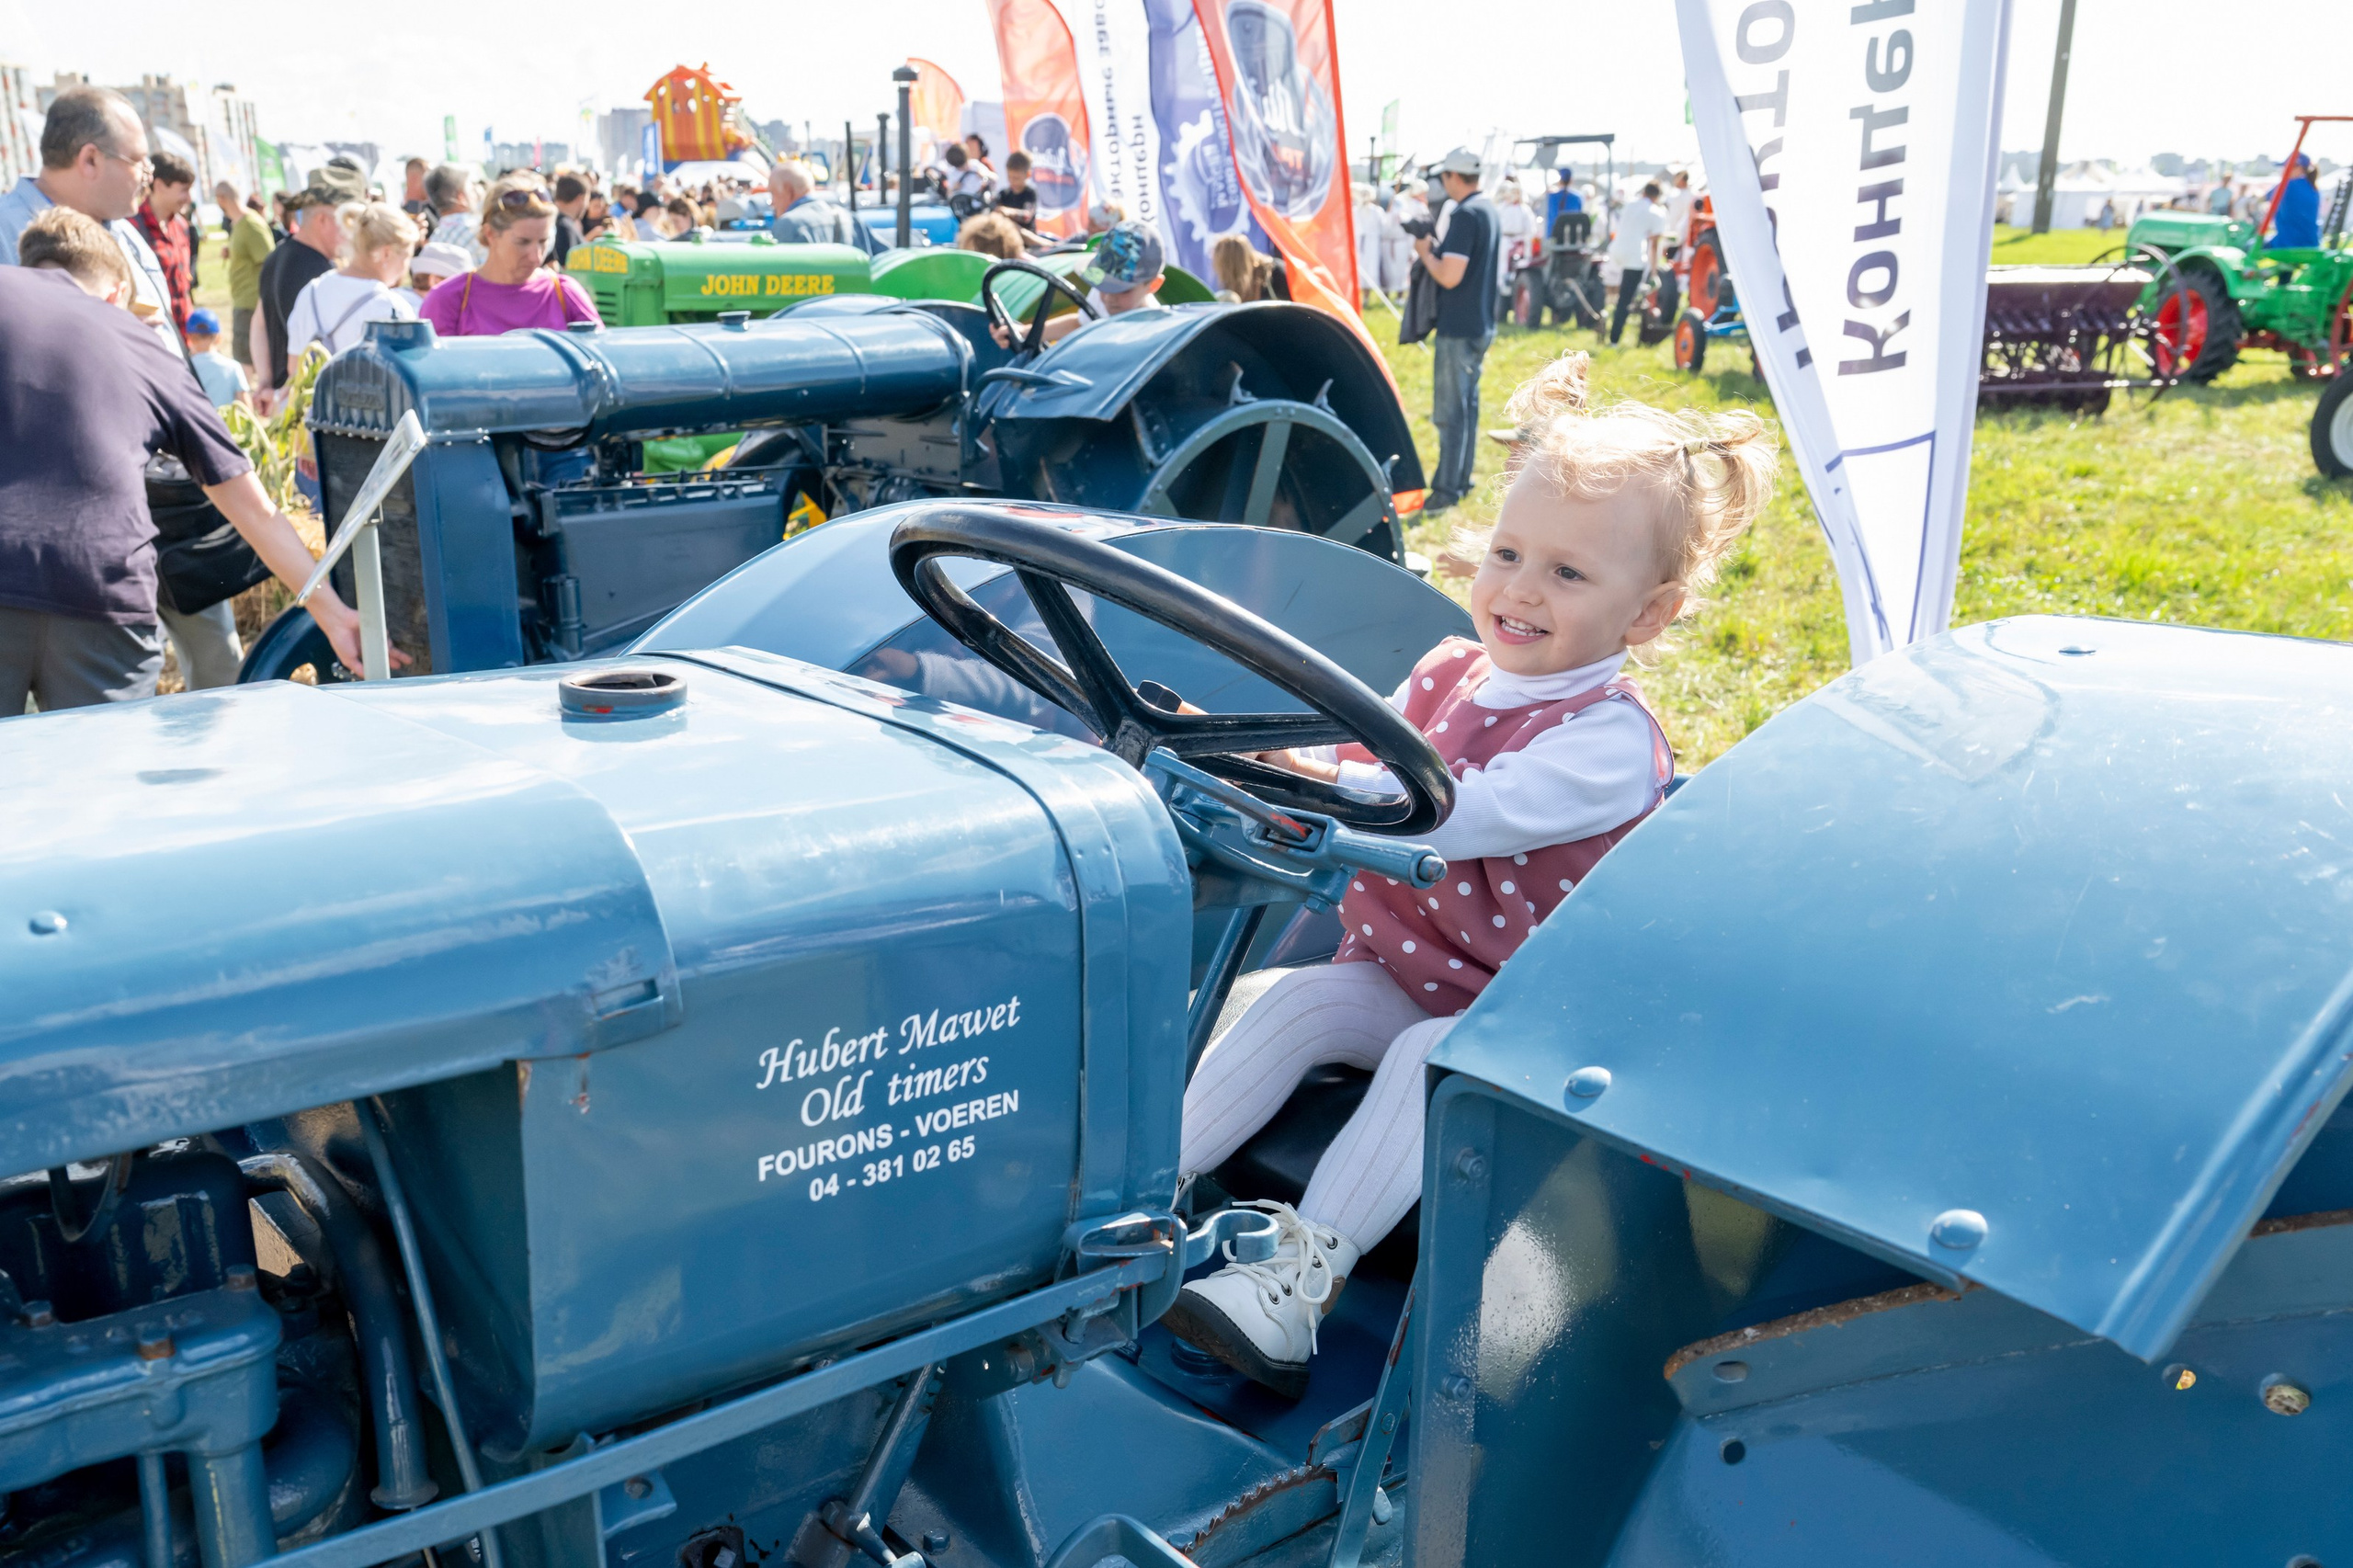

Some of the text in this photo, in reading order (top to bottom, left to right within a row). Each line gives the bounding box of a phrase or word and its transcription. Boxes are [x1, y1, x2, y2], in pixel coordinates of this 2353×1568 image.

[700, 274, 835, 296] JOHN DEERE
[756, 995, 1021, 1089] Hubert Mawet
[801, 1056, 990, 1127] Old timers
[757, 1123, 893, 1181] FOURONS
[915, 1089, 1019, 1137] VOEREN
[809, 1173, 839, 1202] 04
[862, 1154, 904, 1187] 381
[913, 1145, 941, 1172] 02
[948, 1135, 975, 1163] 65
